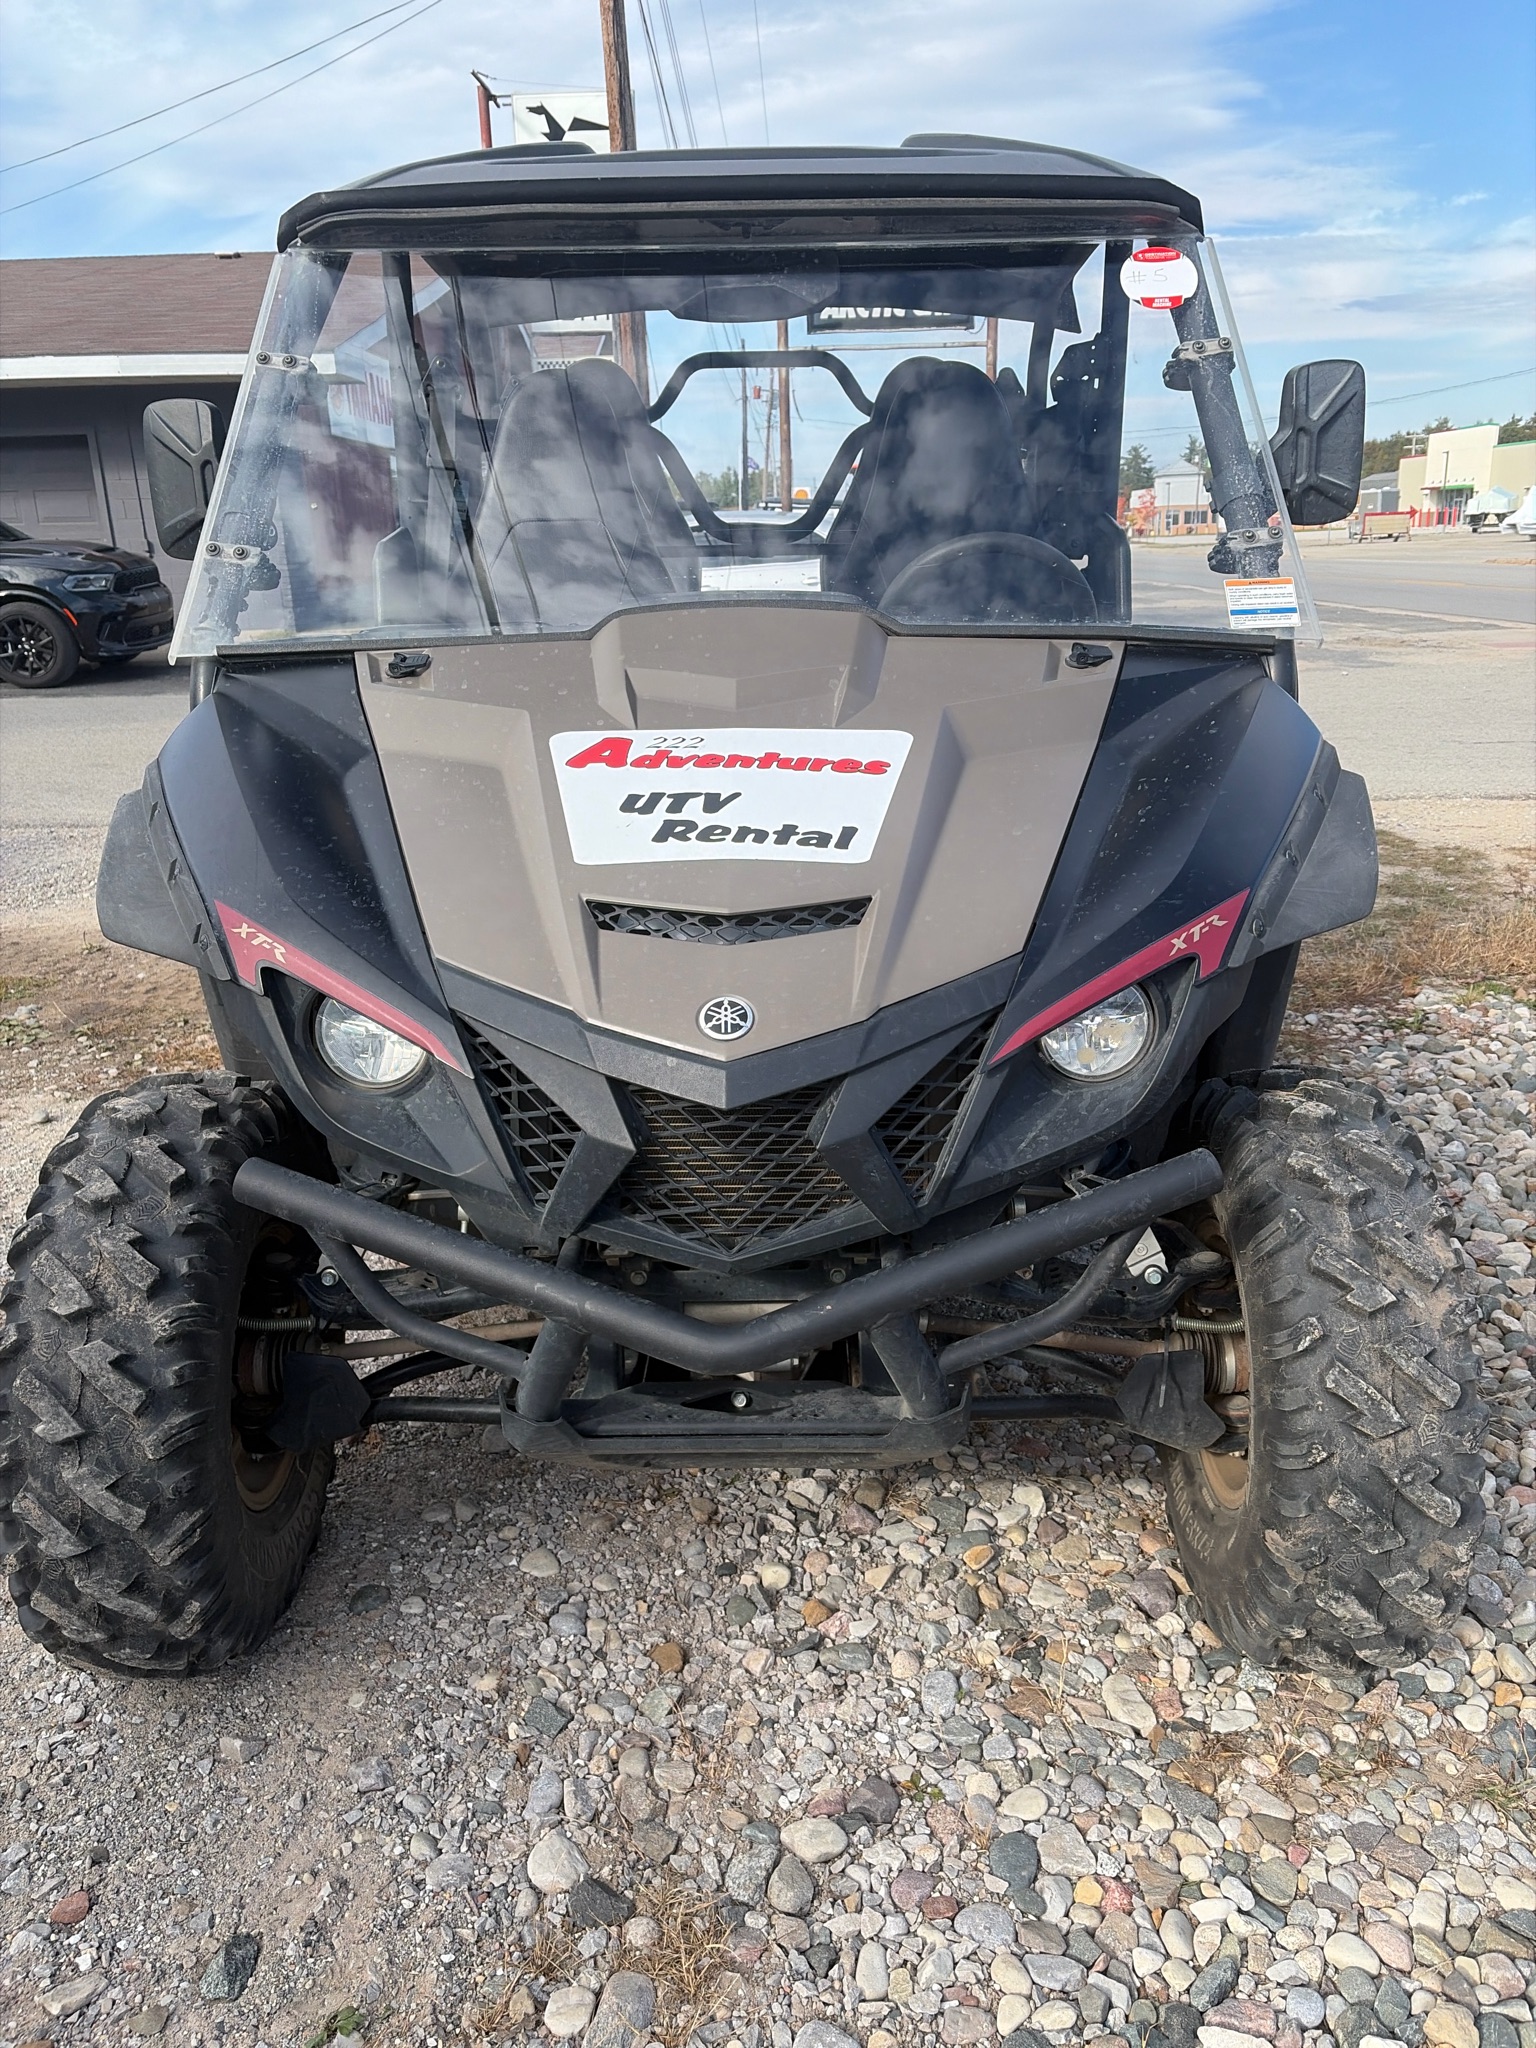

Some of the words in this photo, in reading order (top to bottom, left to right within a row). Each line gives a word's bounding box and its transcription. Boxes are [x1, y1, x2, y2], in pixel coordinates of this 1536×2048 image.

[1152, 268, 1168, 282] 5
[645, 736, 706, 750] 222
[565, 736, 891, 775] Adventures
[651, 819, 859, 850] Rental
